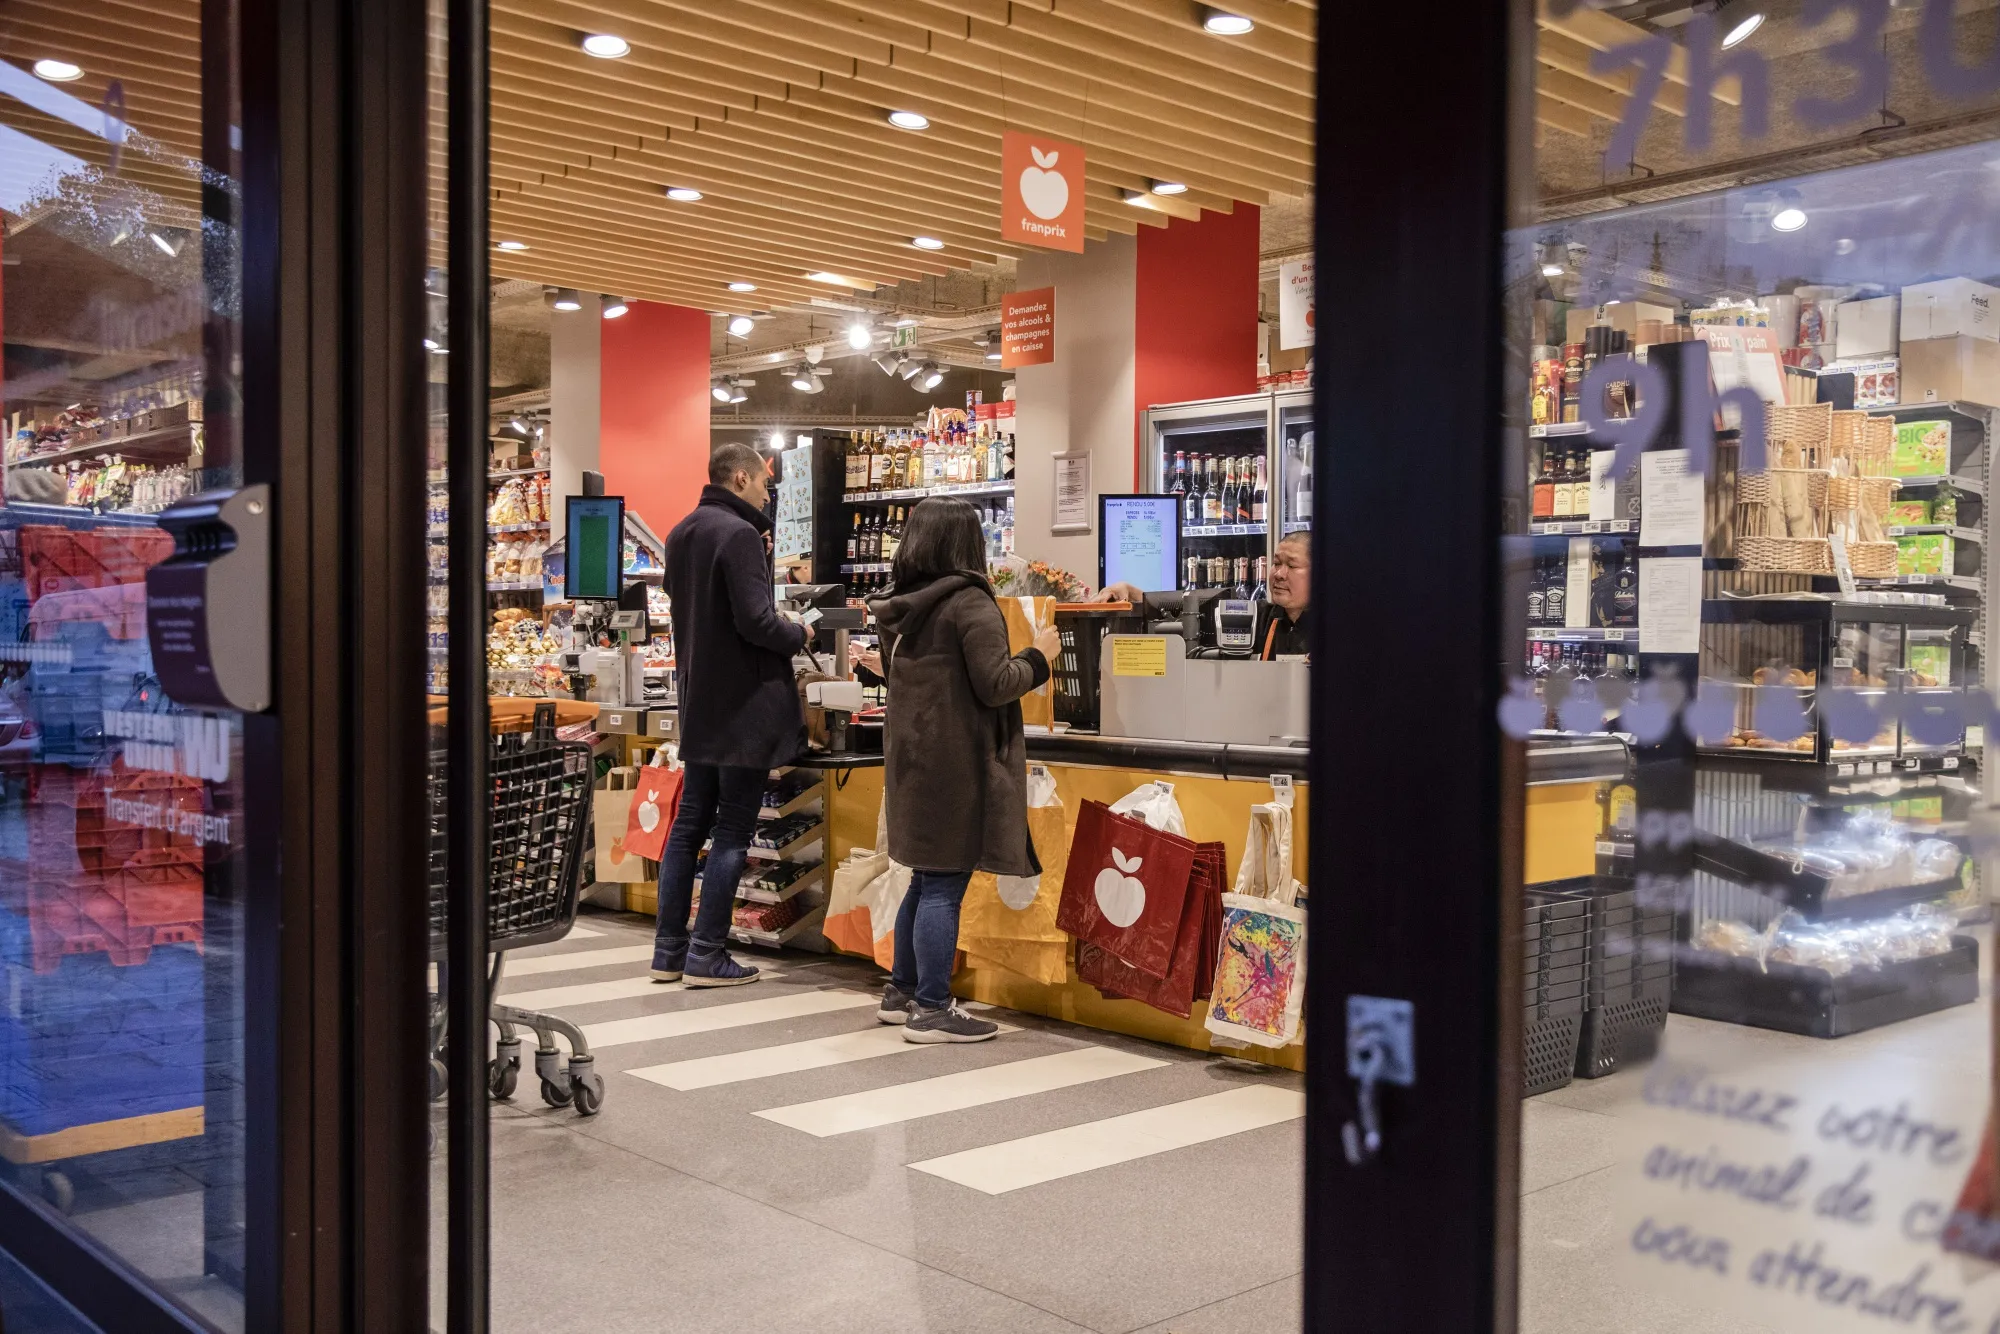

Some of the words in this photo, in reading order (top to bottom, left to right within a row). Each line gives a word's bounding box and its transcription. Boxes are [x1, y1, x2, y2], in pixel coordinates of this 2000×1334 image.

[1021, 217, 1066, 238] franprix
[1008, 302, 1047, 316] Demandez
[1004, 321, 1017, 329] vos
[1018, 315, 1043, 327] alcools
[1044, 313, 1051, 323] &
[1005, 329, 1050, 342] champagnes
[1709, 331, 1731, 349] Prix
[1746, 334, 1768, 352] pain
[1011, 345, 1021, 353] en
[1022, 342, 1044, 352] caisse
[1899, 427, 1928, 445] BIO
[1922, 538, 1939, 548] BIO
[548, 575, 565, 585] Kinde
[104, 710, 175, 741] WESTERN
[104, 787, 162, 829] Transfert
[165, 800, 230, 847] d'argent
[1815, 1099, 1967, 1167] votre
[1641, 1142, 1812, 1214] animal
[1811, 1160, 1877, 1228] de
[1746, 1237, 1976, 1334] attendre
